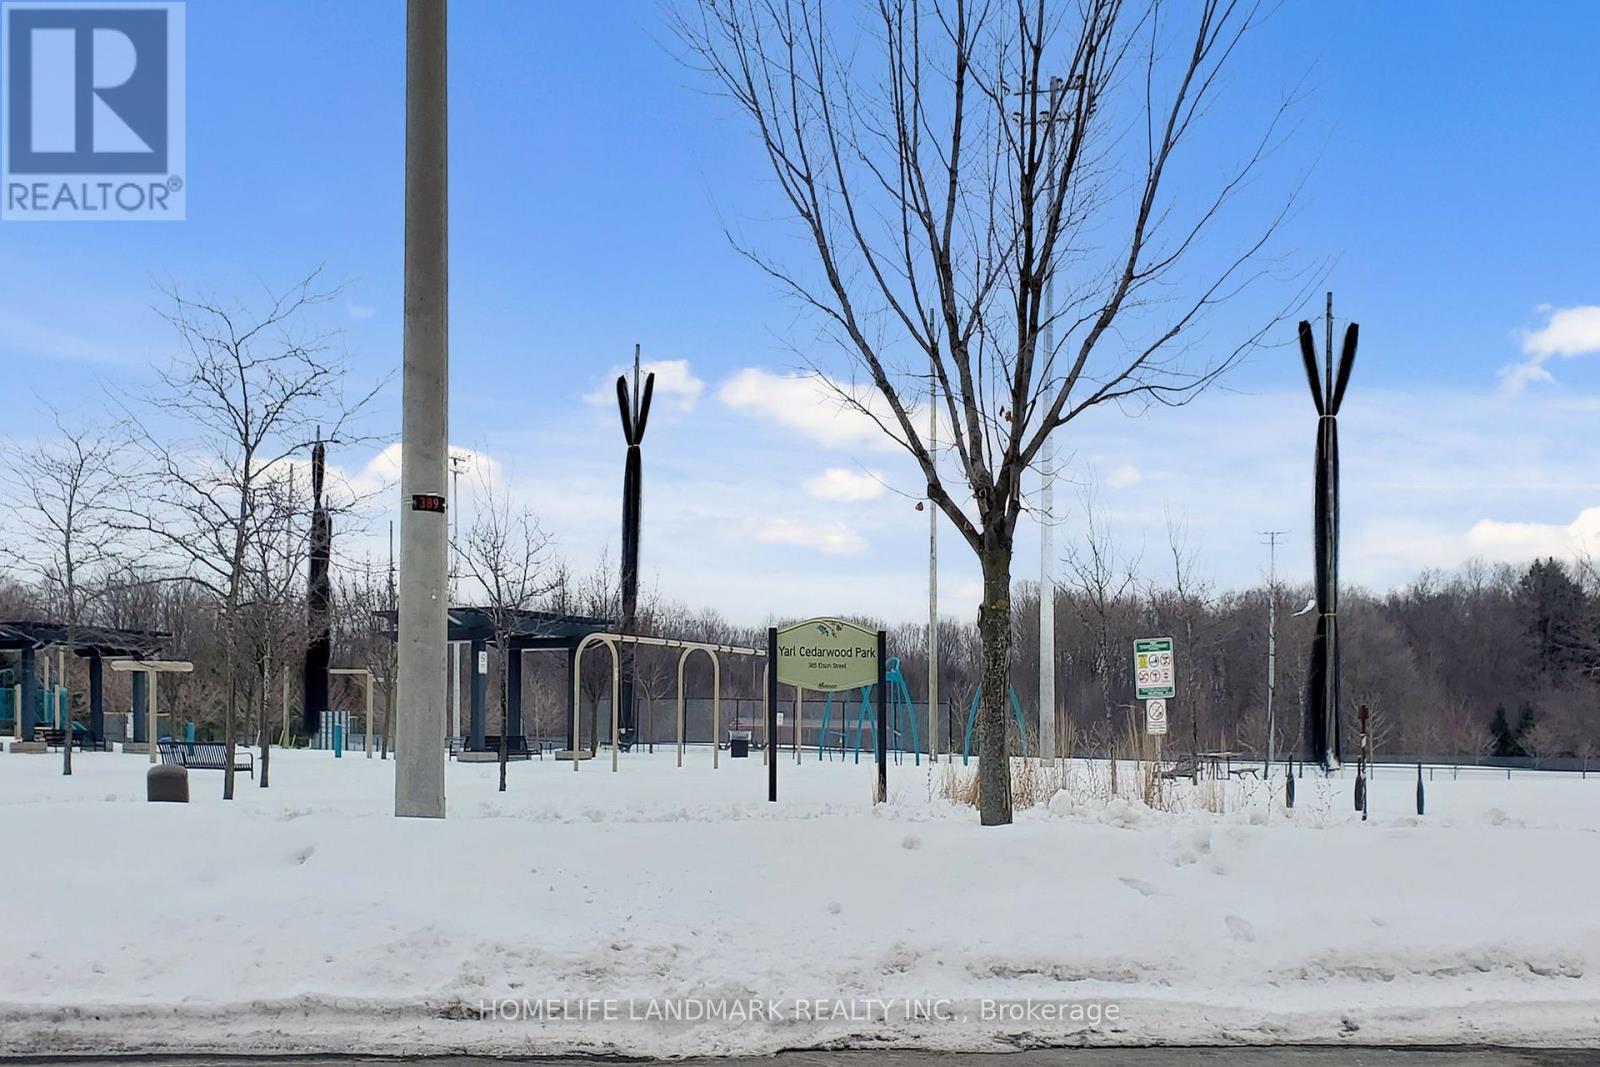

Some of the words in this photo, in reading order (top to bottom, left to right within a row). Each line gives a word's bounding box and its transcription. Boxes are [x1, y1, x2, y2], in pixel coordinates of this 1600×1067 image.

[420, 497, 439, 509] 389
[779, 646, 796, 657] Yarl
[799, 646, 853, 658] Cedarwood
[855, 647, 876, 658] Park
